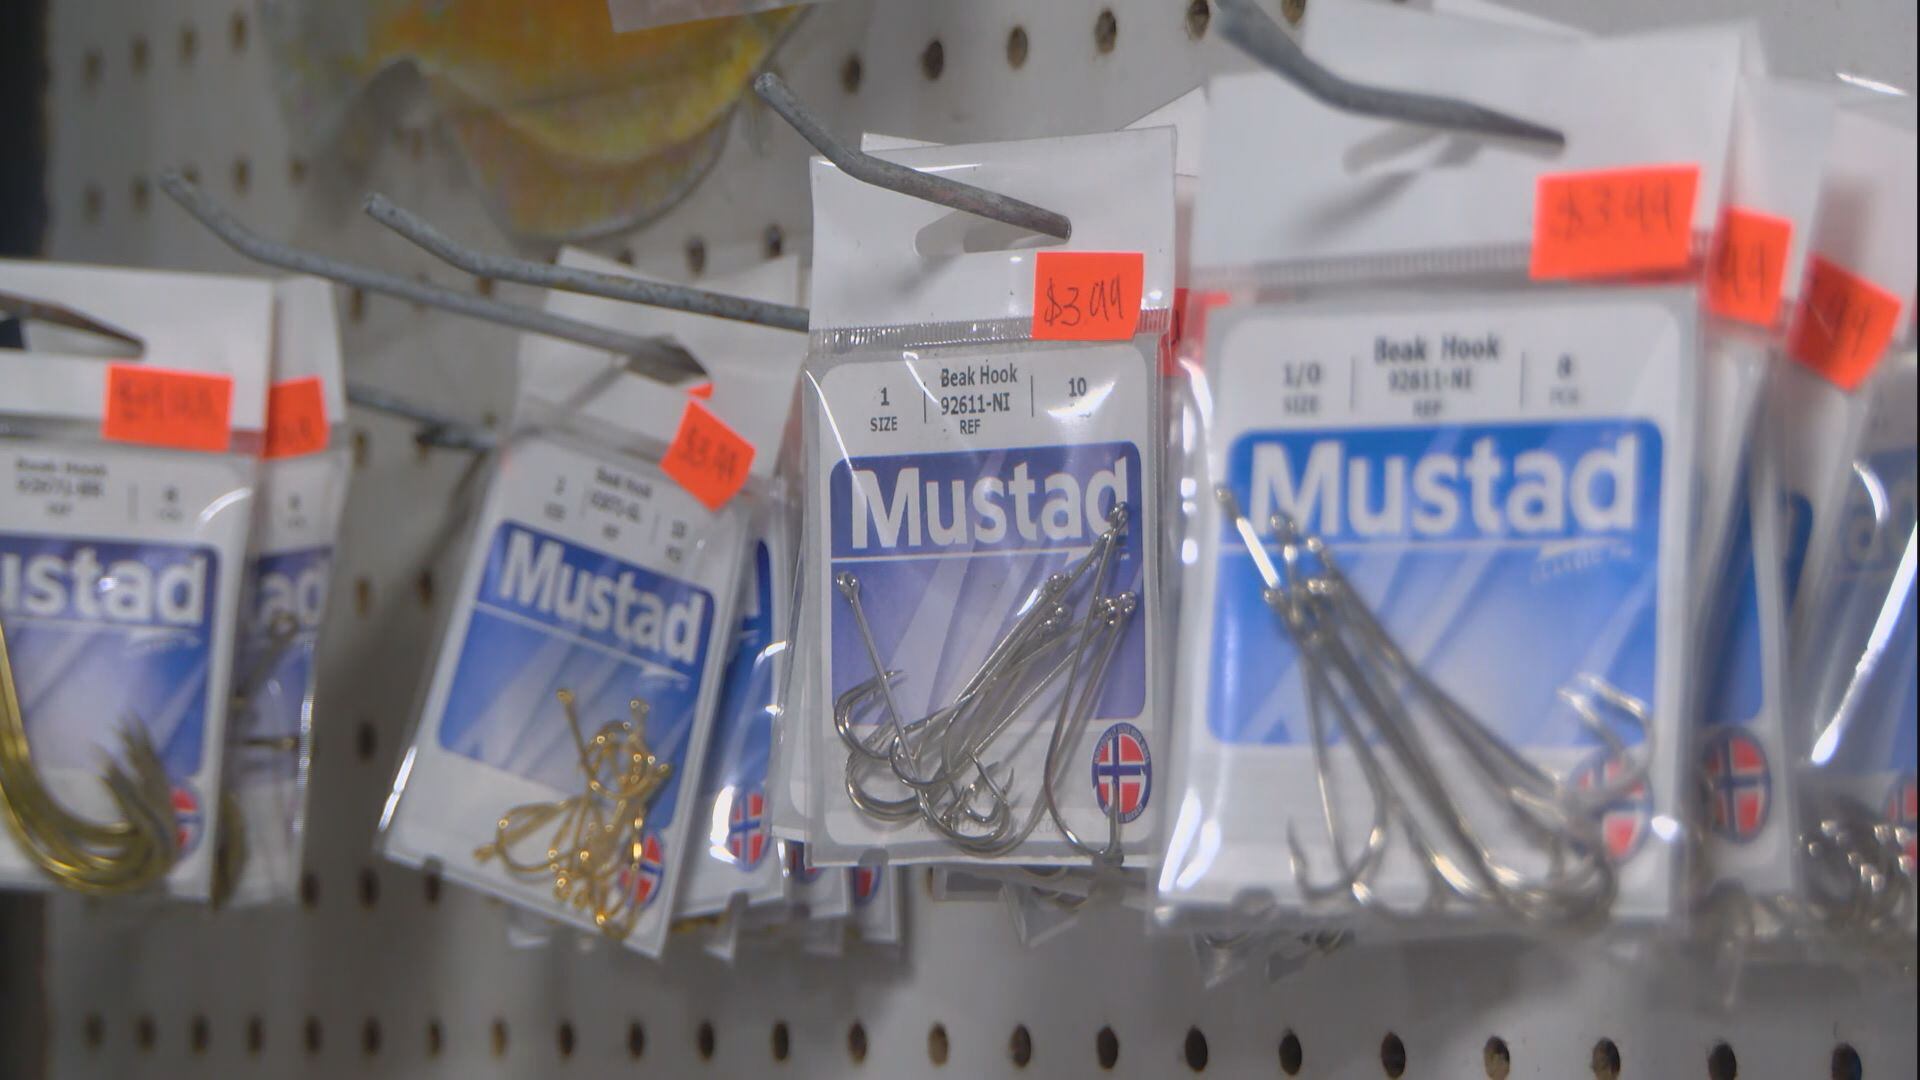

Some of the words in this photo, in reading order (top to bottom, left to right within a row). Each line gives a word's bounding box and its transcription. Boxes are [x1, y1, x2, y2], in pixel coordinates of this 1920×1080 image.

[1374, 334, 1427, 364] Beak
[1441, 332, 1500, 361] Hook
[941, 365, 975, 388] Beak
[980, 362, 1018, 385] Hook
[1068, 377, 1087, 397] 10
[1283, 361, 1322, 388] 1/0
[880, 387, 890, 406] 1
[941, 393, 1011, 416] 92611-NI
[870, 416, 898, 432] SIZE
[959, 419, 981, 435] REF
[1248, 430, 1640, 537] Mustad
[851, 455, 1130, 550] Mustad
[502, 528, 707, 666] Mustad
